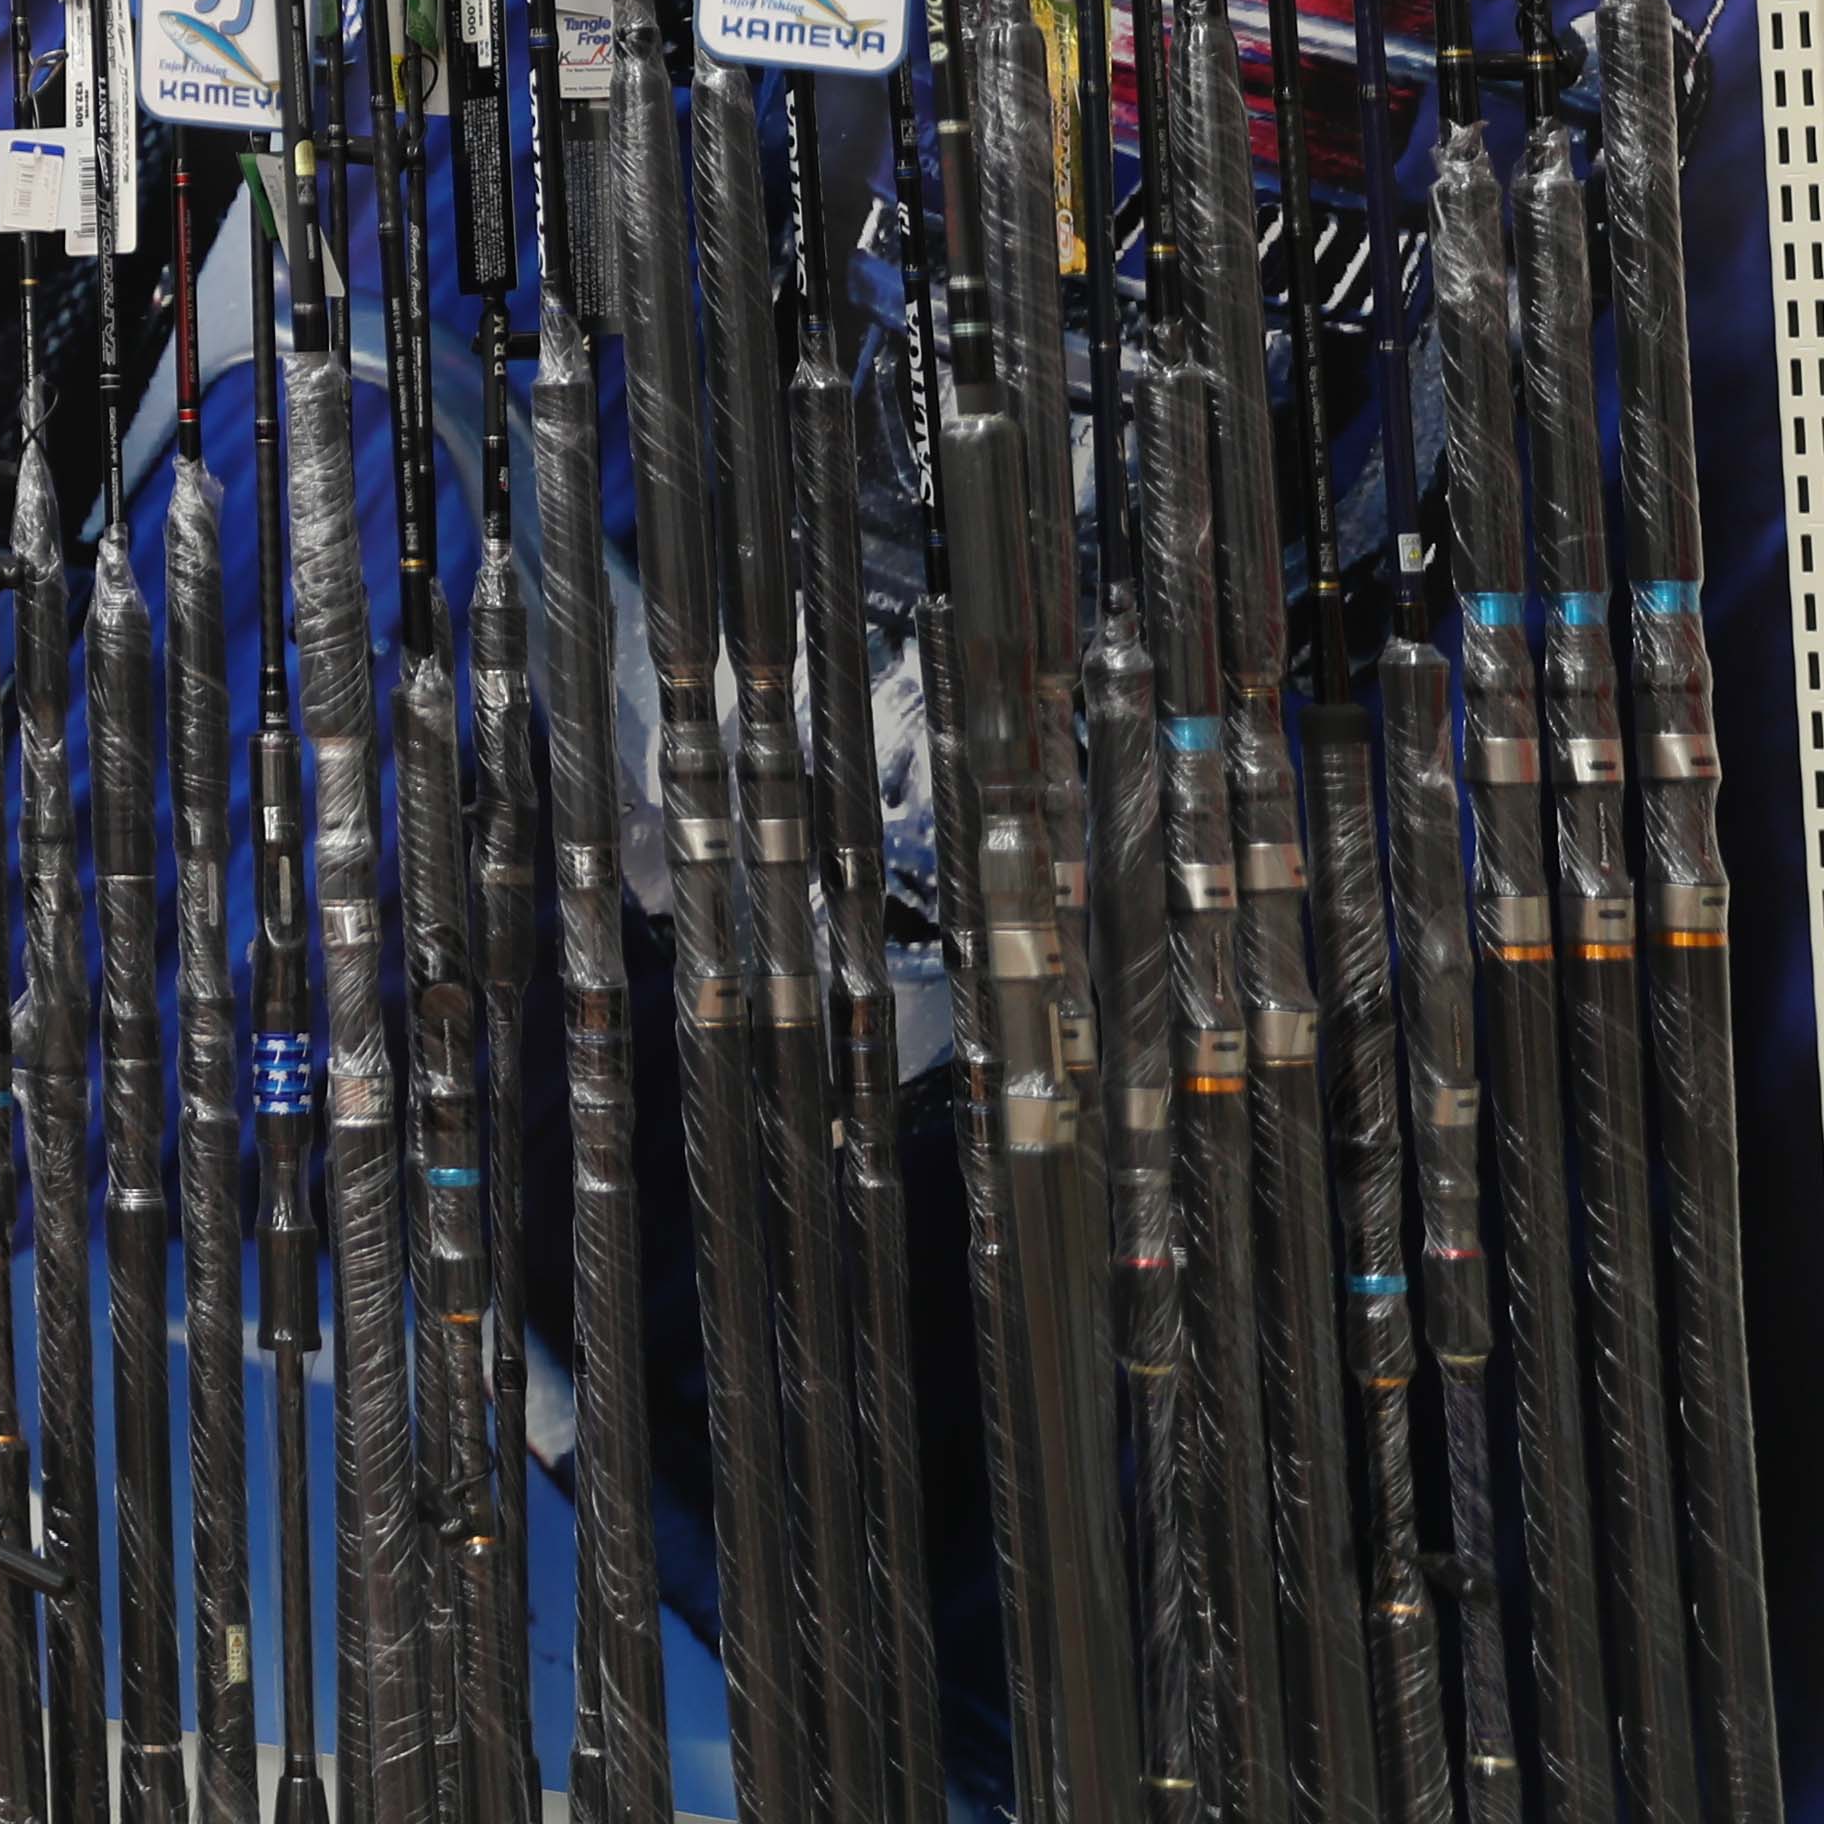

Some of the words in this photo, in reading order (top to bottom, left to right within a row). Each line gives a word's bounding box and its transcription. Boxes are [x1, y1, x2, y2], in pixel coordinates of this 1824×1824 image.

[563, 17, 612, 32] Tangle
[577, 32, 612, 46] Free
[721, 17, 886, 55] KAMEYA
